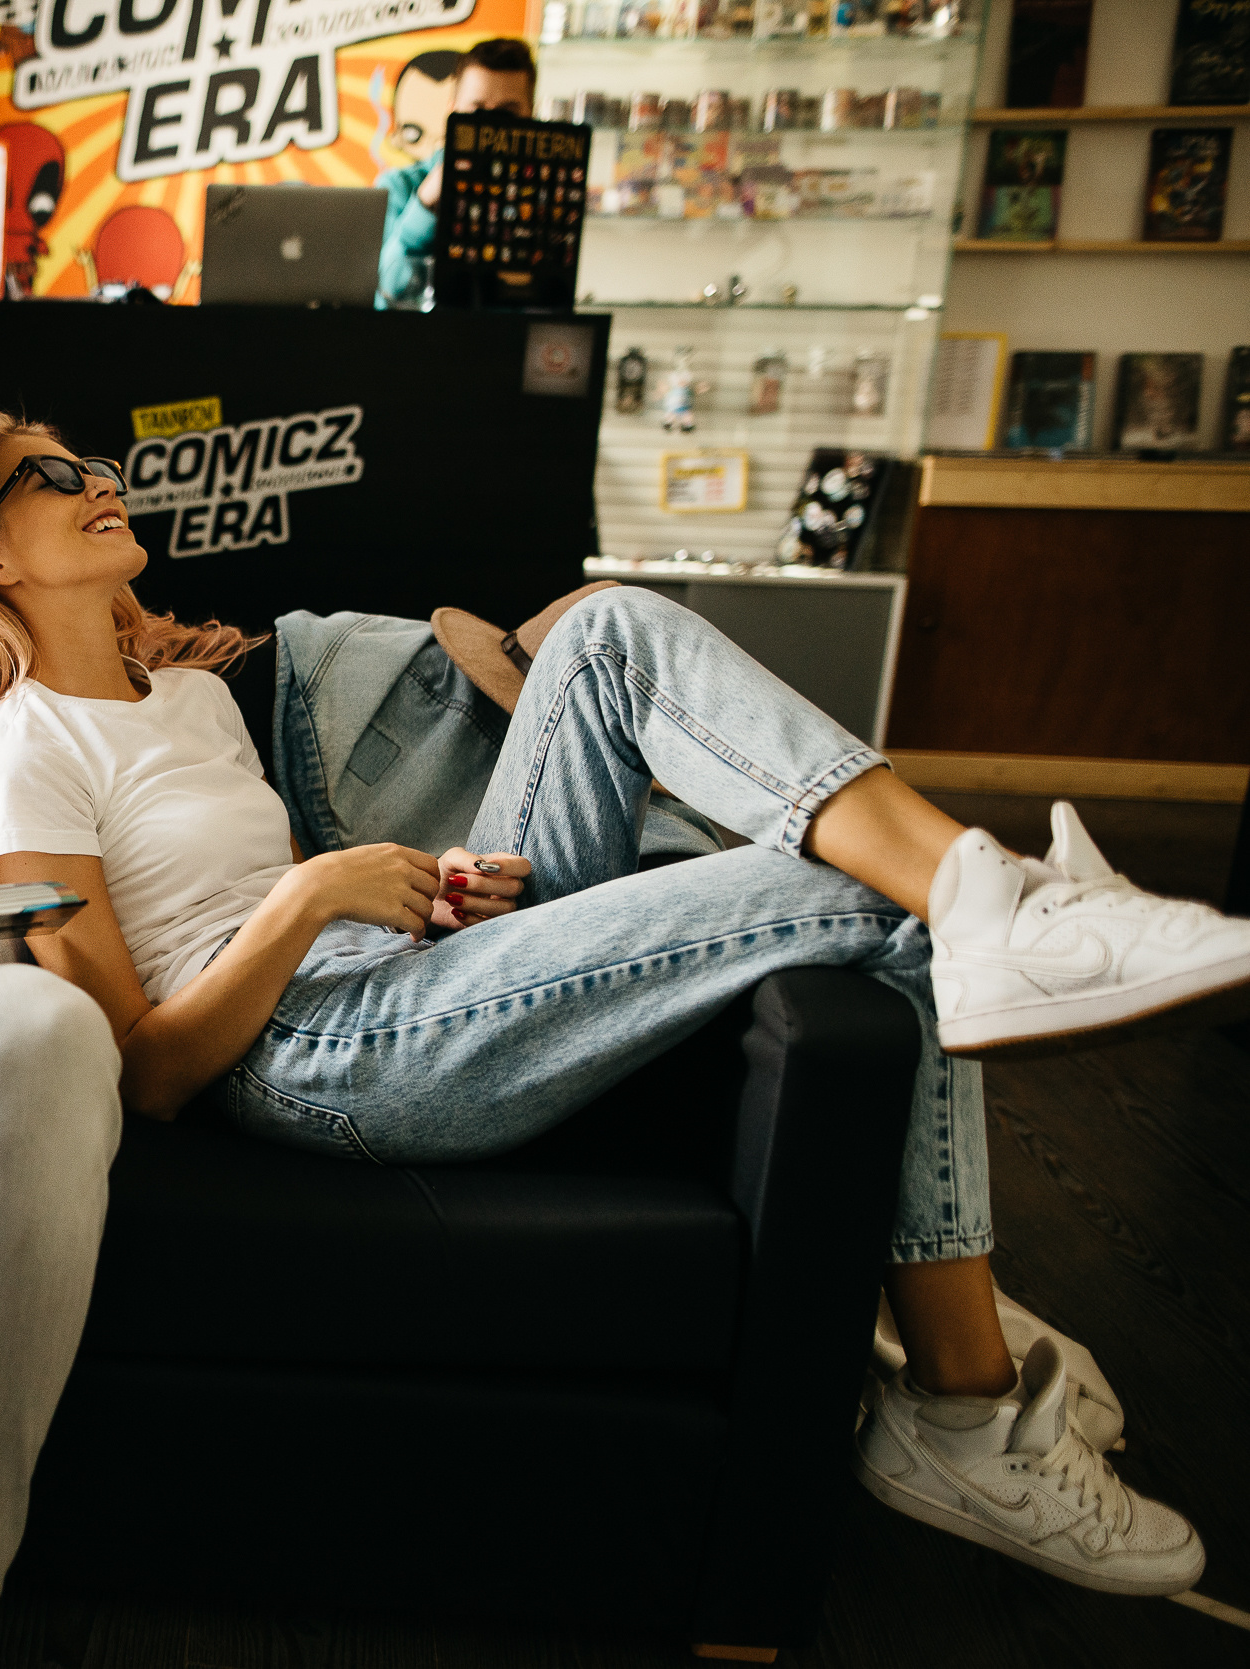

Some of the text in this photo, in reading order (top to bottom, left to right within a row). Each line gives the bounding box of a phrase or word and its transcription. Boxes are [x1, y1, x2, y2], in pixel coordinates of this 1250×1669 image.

[133, 53, 324, 165] ERA
[477, 126, 586, 160] PATTERN
[129, 412, 357, 499] COMICZ
[175, 494, 283, 551] ERA
